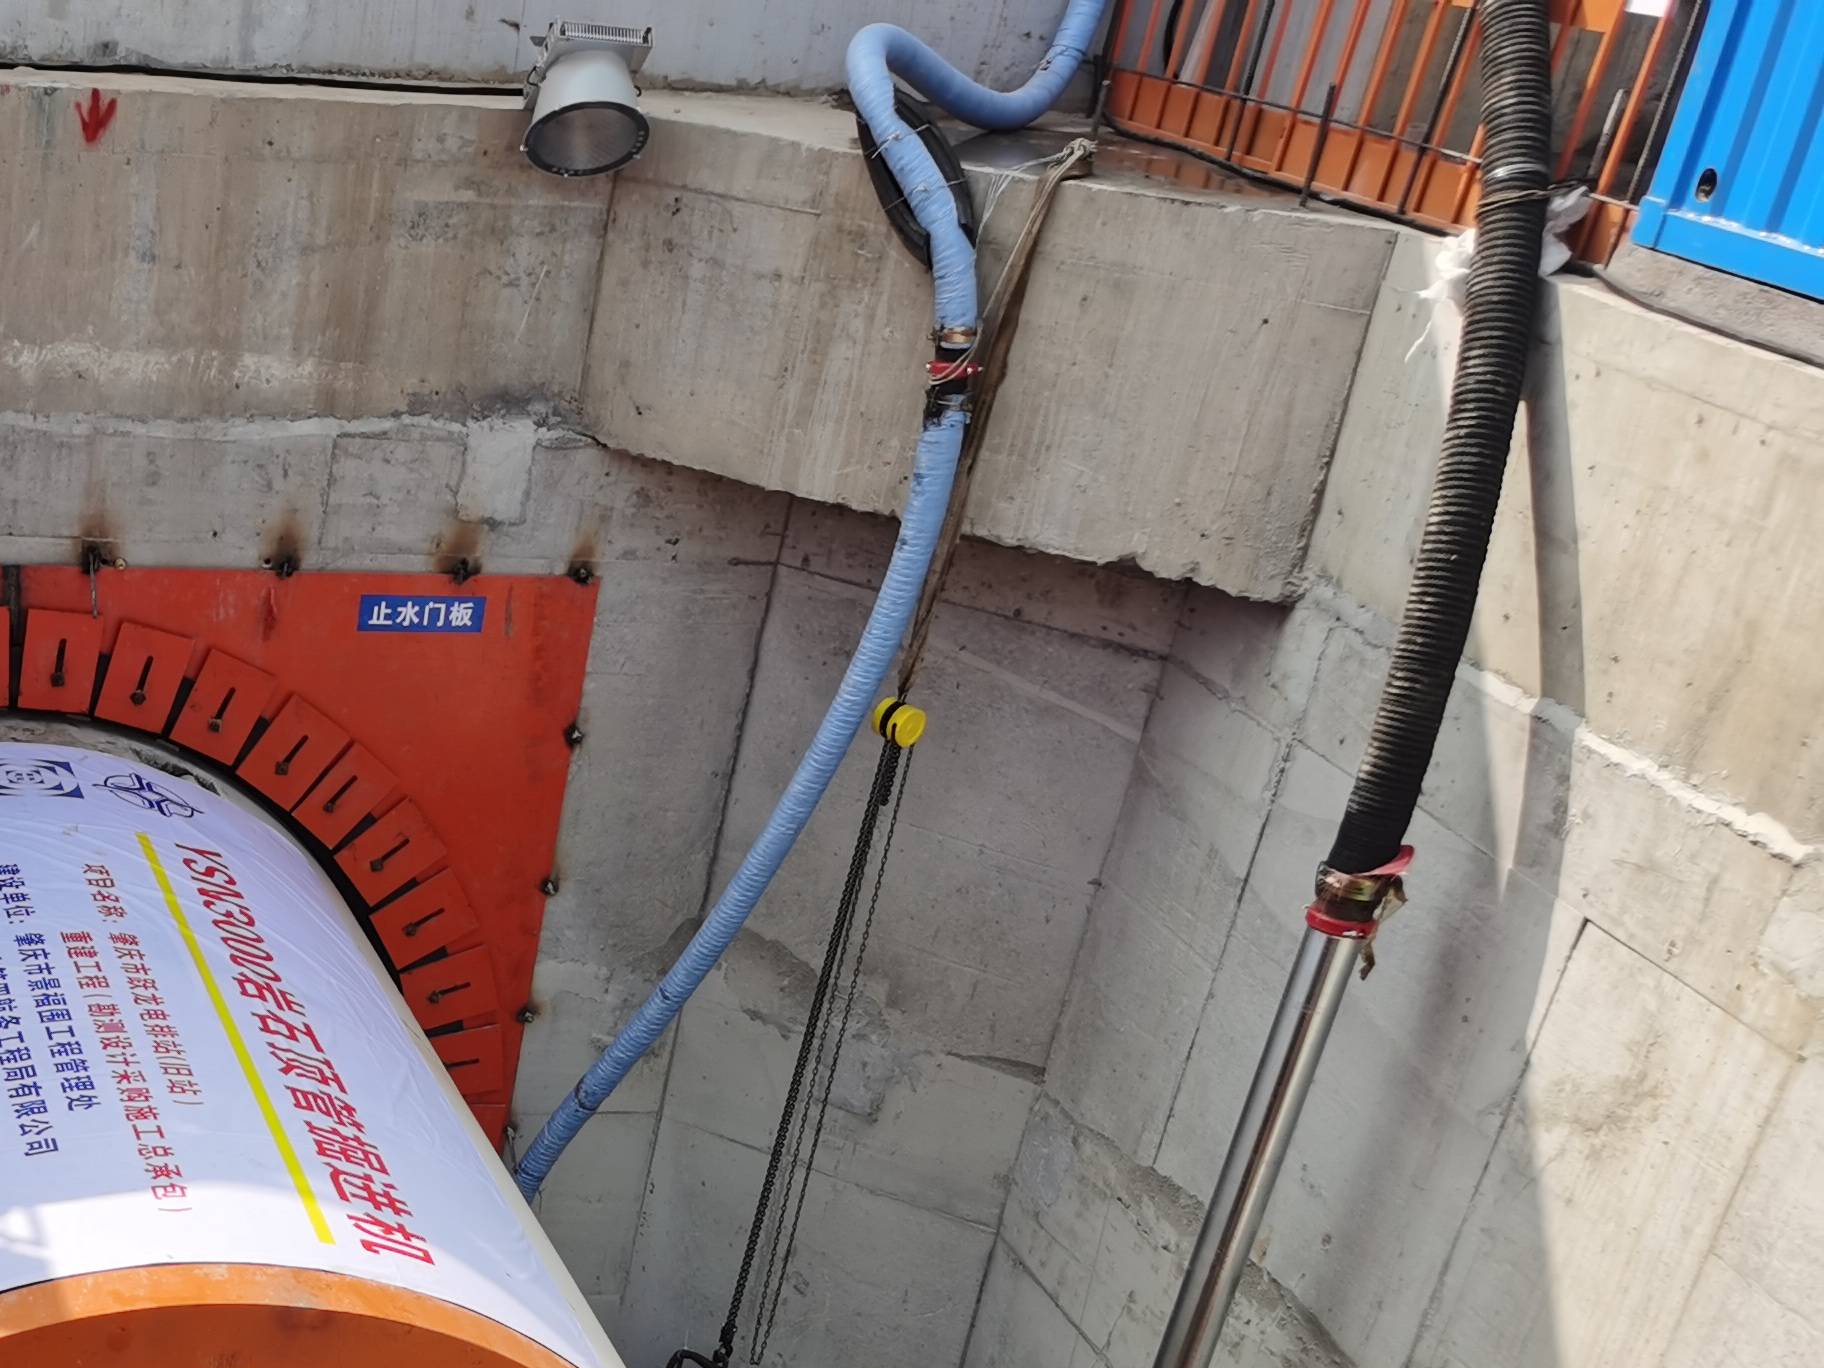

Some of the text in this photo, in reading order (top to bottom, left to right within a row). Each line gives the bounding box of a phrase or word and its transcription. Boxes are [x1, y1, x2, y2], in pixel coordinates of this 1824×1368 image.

[368, 600, 475, 628] 止水门板
[174, 842, 436, 1267] YSN3000岩石顶管掘进机
